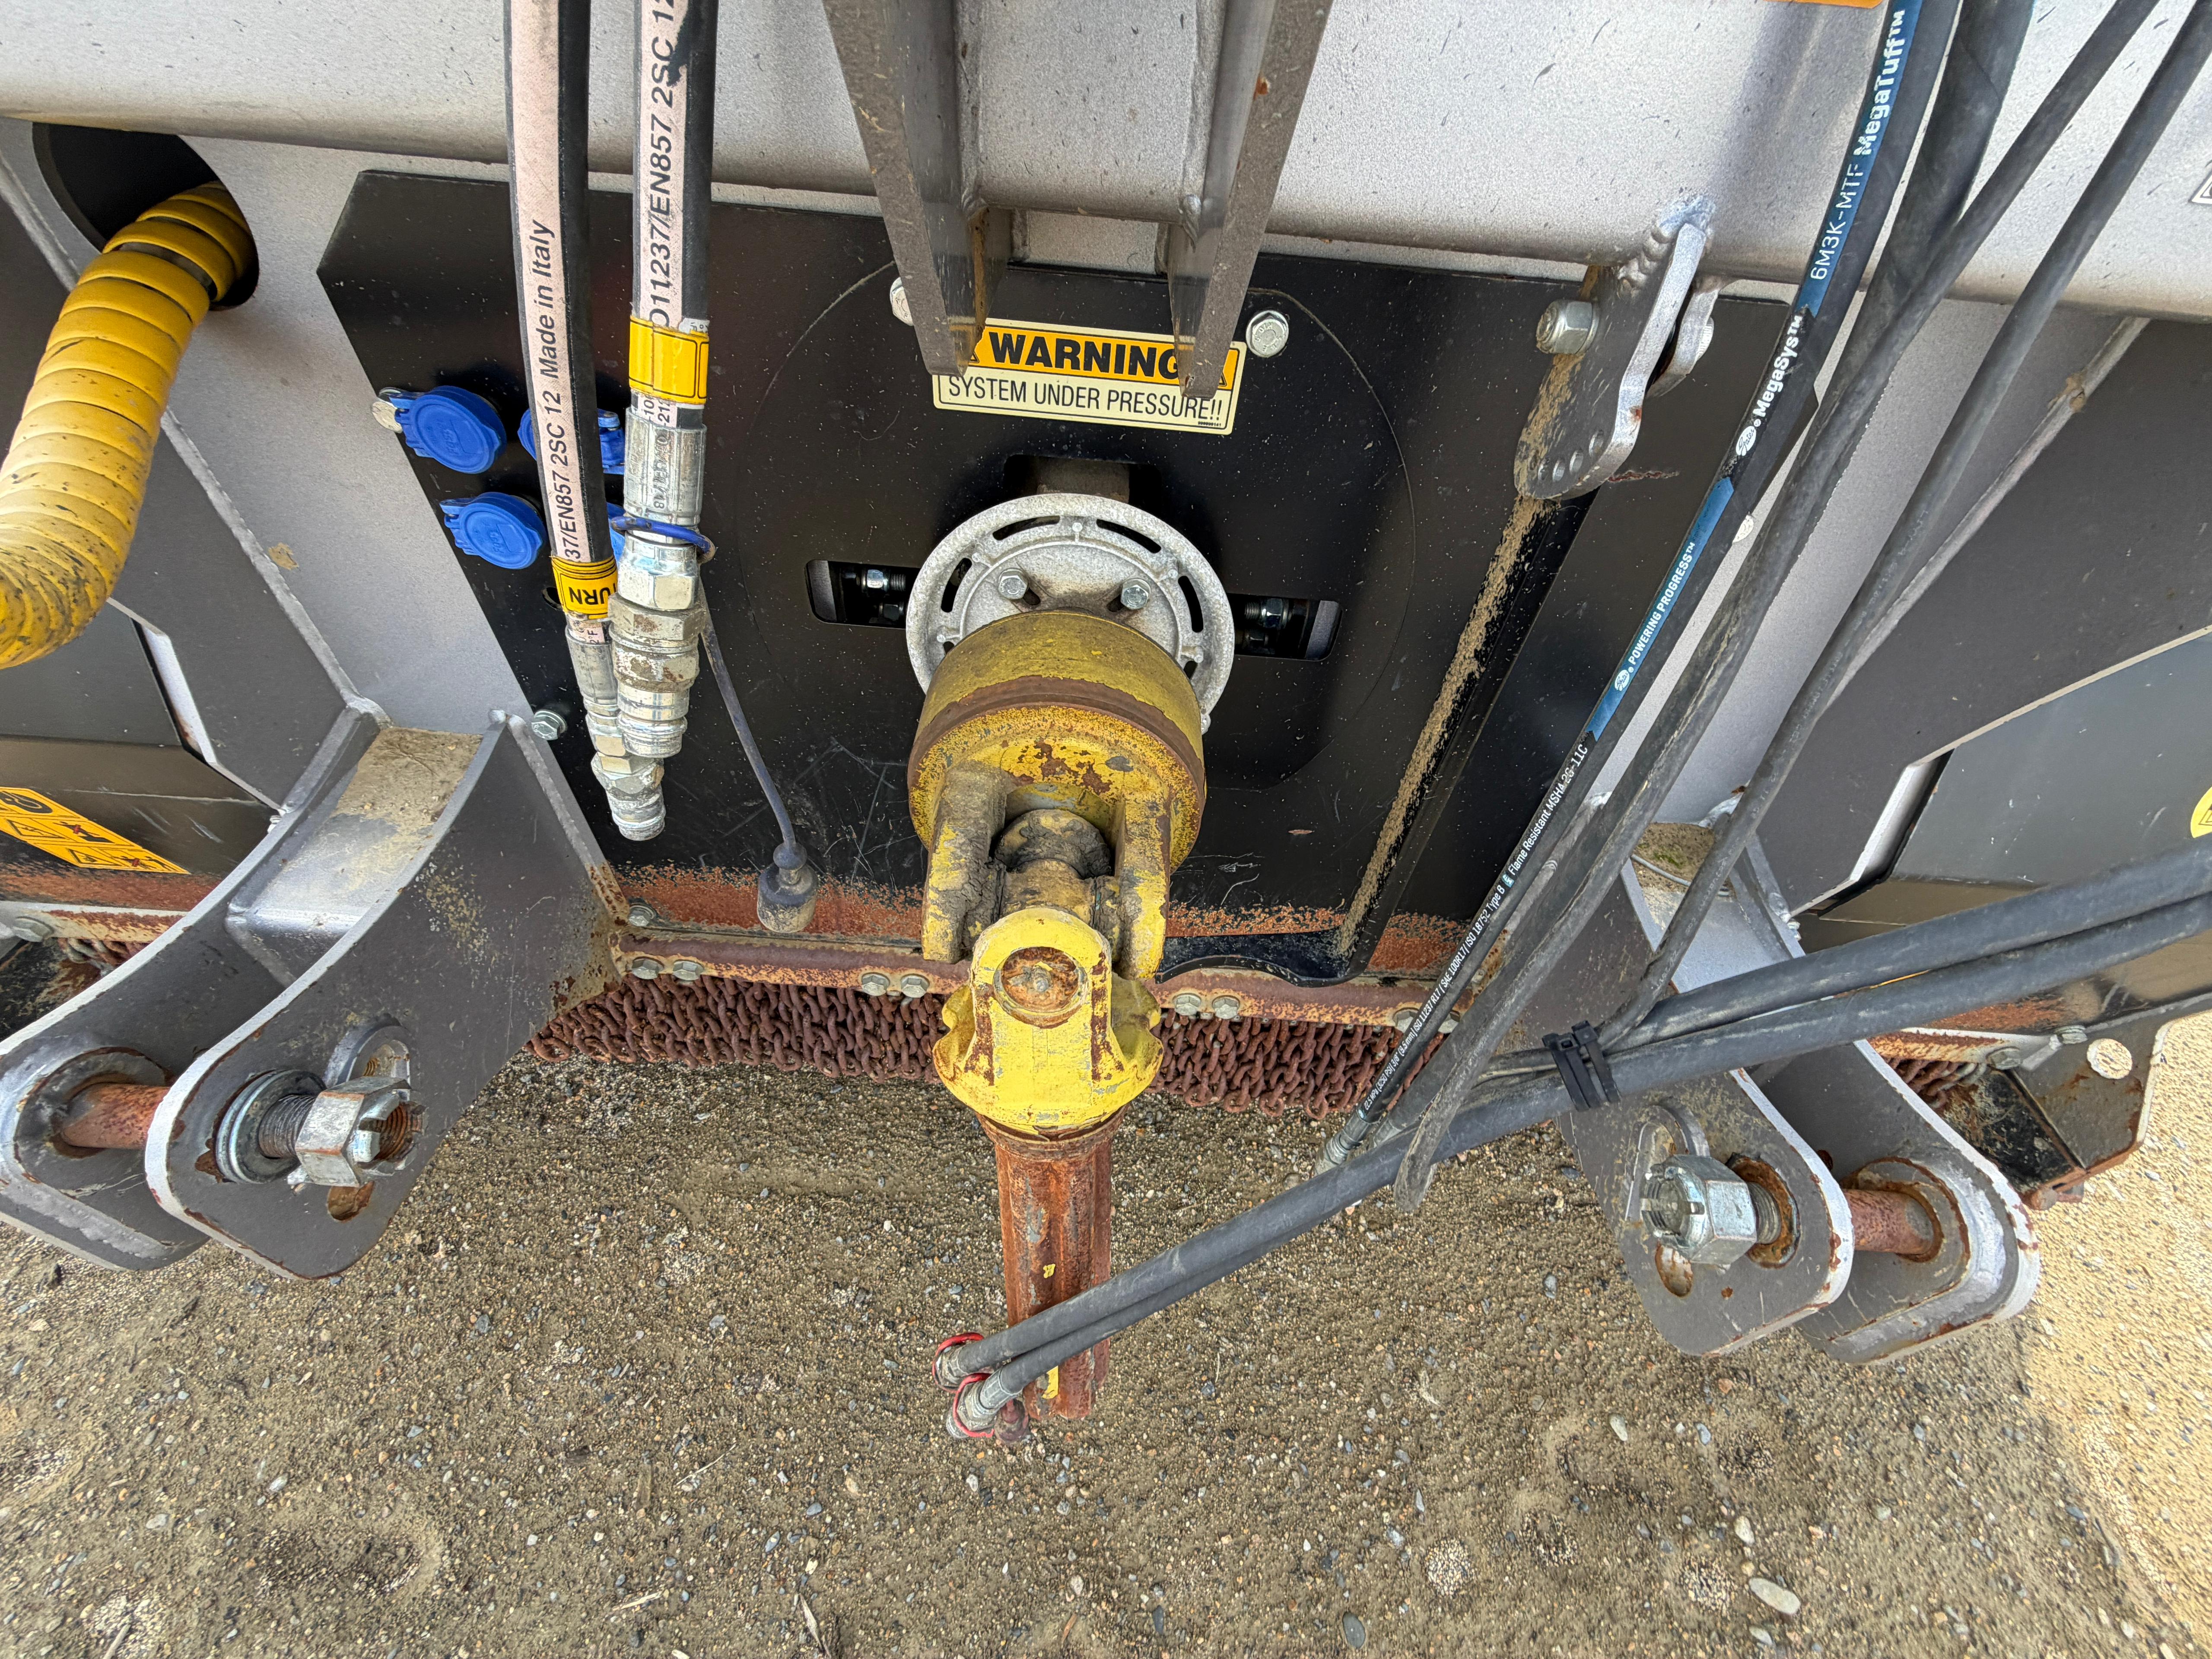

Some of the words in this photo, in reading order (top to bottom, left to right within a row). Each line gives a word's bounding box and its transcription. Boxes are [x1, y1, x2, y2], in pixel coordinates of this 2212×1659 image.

[652, 36, 674, 108] 2SC
[529, 219, 556, 278] Italy
[1810, 164, 1863, 280] 6M3K-MTF
[534, 285, 553, 309] in
[538, 314, 559, 379] Made
[542, 390, 561, 414] 12
[949, 375, 1027, 403] SYSTEM
[1035, 383, 1100, 410] UNDER
[1107, 389, 1222, 421] PRESSURE!!
[546, 422, 569, 467] 2SC
[552, 469, 581, 559] 37/EN857
[1628, 612, 1662, 665] POWERING
[1419, 1001, 1435, 1020] 11237
[1440, 972, 1453, 988] SAE
[1466, 932, 1477, 947] ISO
[1472, 909, 1491, 937] 18752
[1486, 892, 1501, 911] Type
[1497, 884, 1505, 894] B
[1508, 849, 1528, 876] Flame
[1522, 809, 1551, 851] Resistant
[1545, 782, 1567, 811] MSHA
